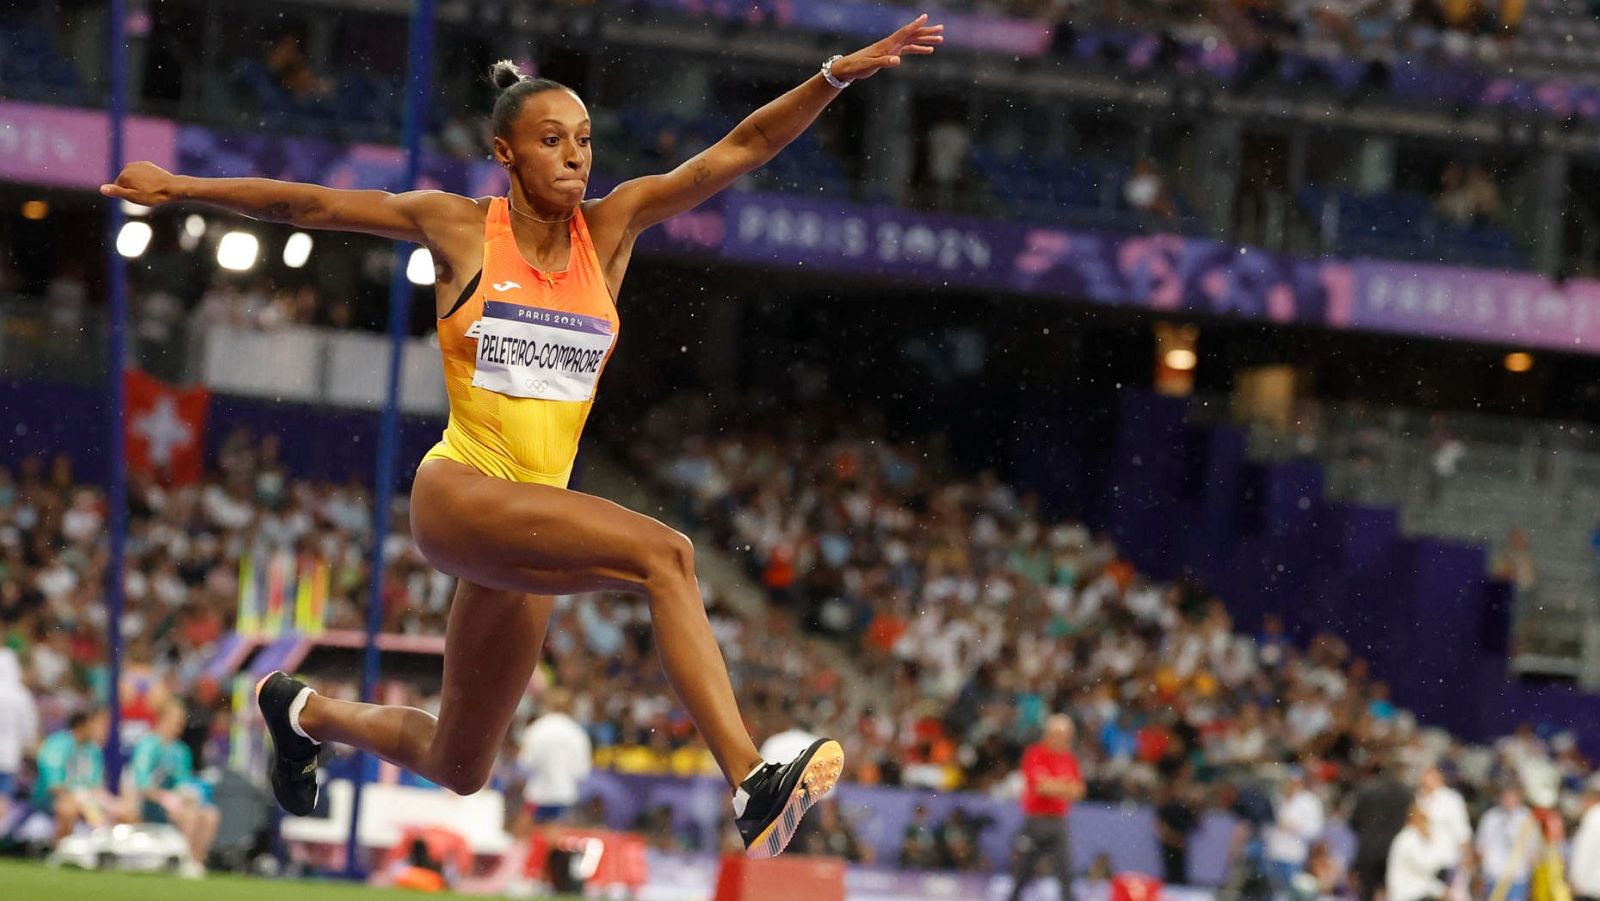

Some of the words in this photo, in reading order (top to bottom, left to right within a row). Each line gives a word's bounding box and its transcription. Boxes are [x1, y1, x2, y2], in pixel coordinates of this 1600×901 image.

[738, 204, 867, 257] PARIS
[876, 220, 992, 269] 2024
[518, 309, 551, 322] PARIS
[554, 315, 583, 327] 2024
[480, 334, 604, 373] PELETEIRO-COMPAORE
